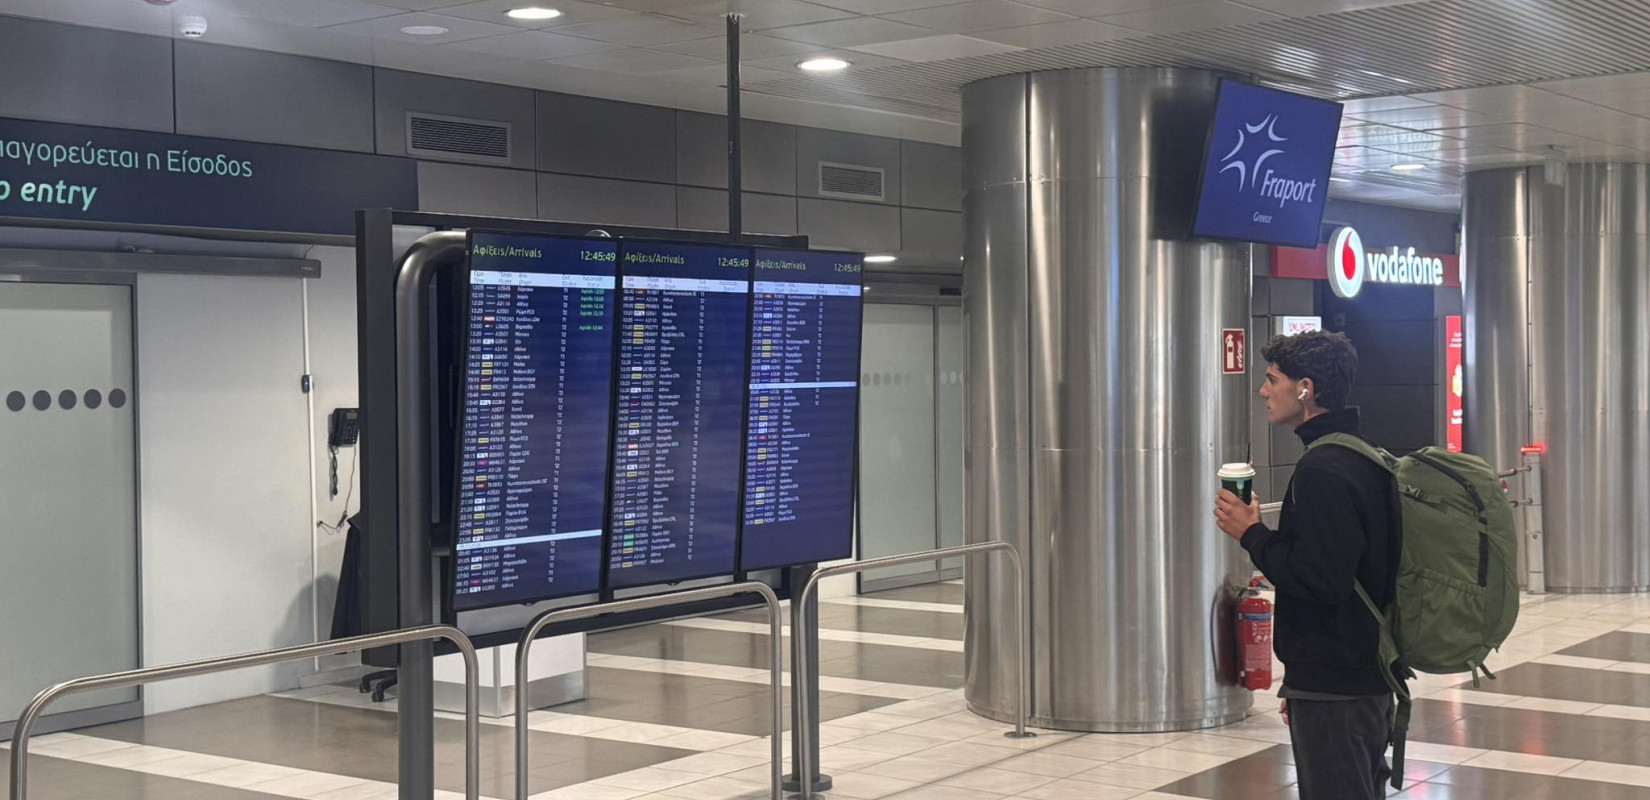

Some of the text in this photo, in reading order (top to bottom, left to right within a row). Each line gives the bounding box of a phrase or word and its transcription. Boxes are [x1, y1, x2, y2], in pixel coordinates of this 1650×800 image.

[0, 140, 253, 177] αγορεύεται η Είσοδος
[20, 180, 97, 211] entry
[1260, 169, 1316, 208] Fraport
[1253, 212, 1272, 223] Greece
[580, 251, 616, 262] 12:45:49
[718, 257, 749, 268] 12:45:49
[1367, 246, 1443, 285] vodafone
[834, 264, 861, 272] 12:45:49
